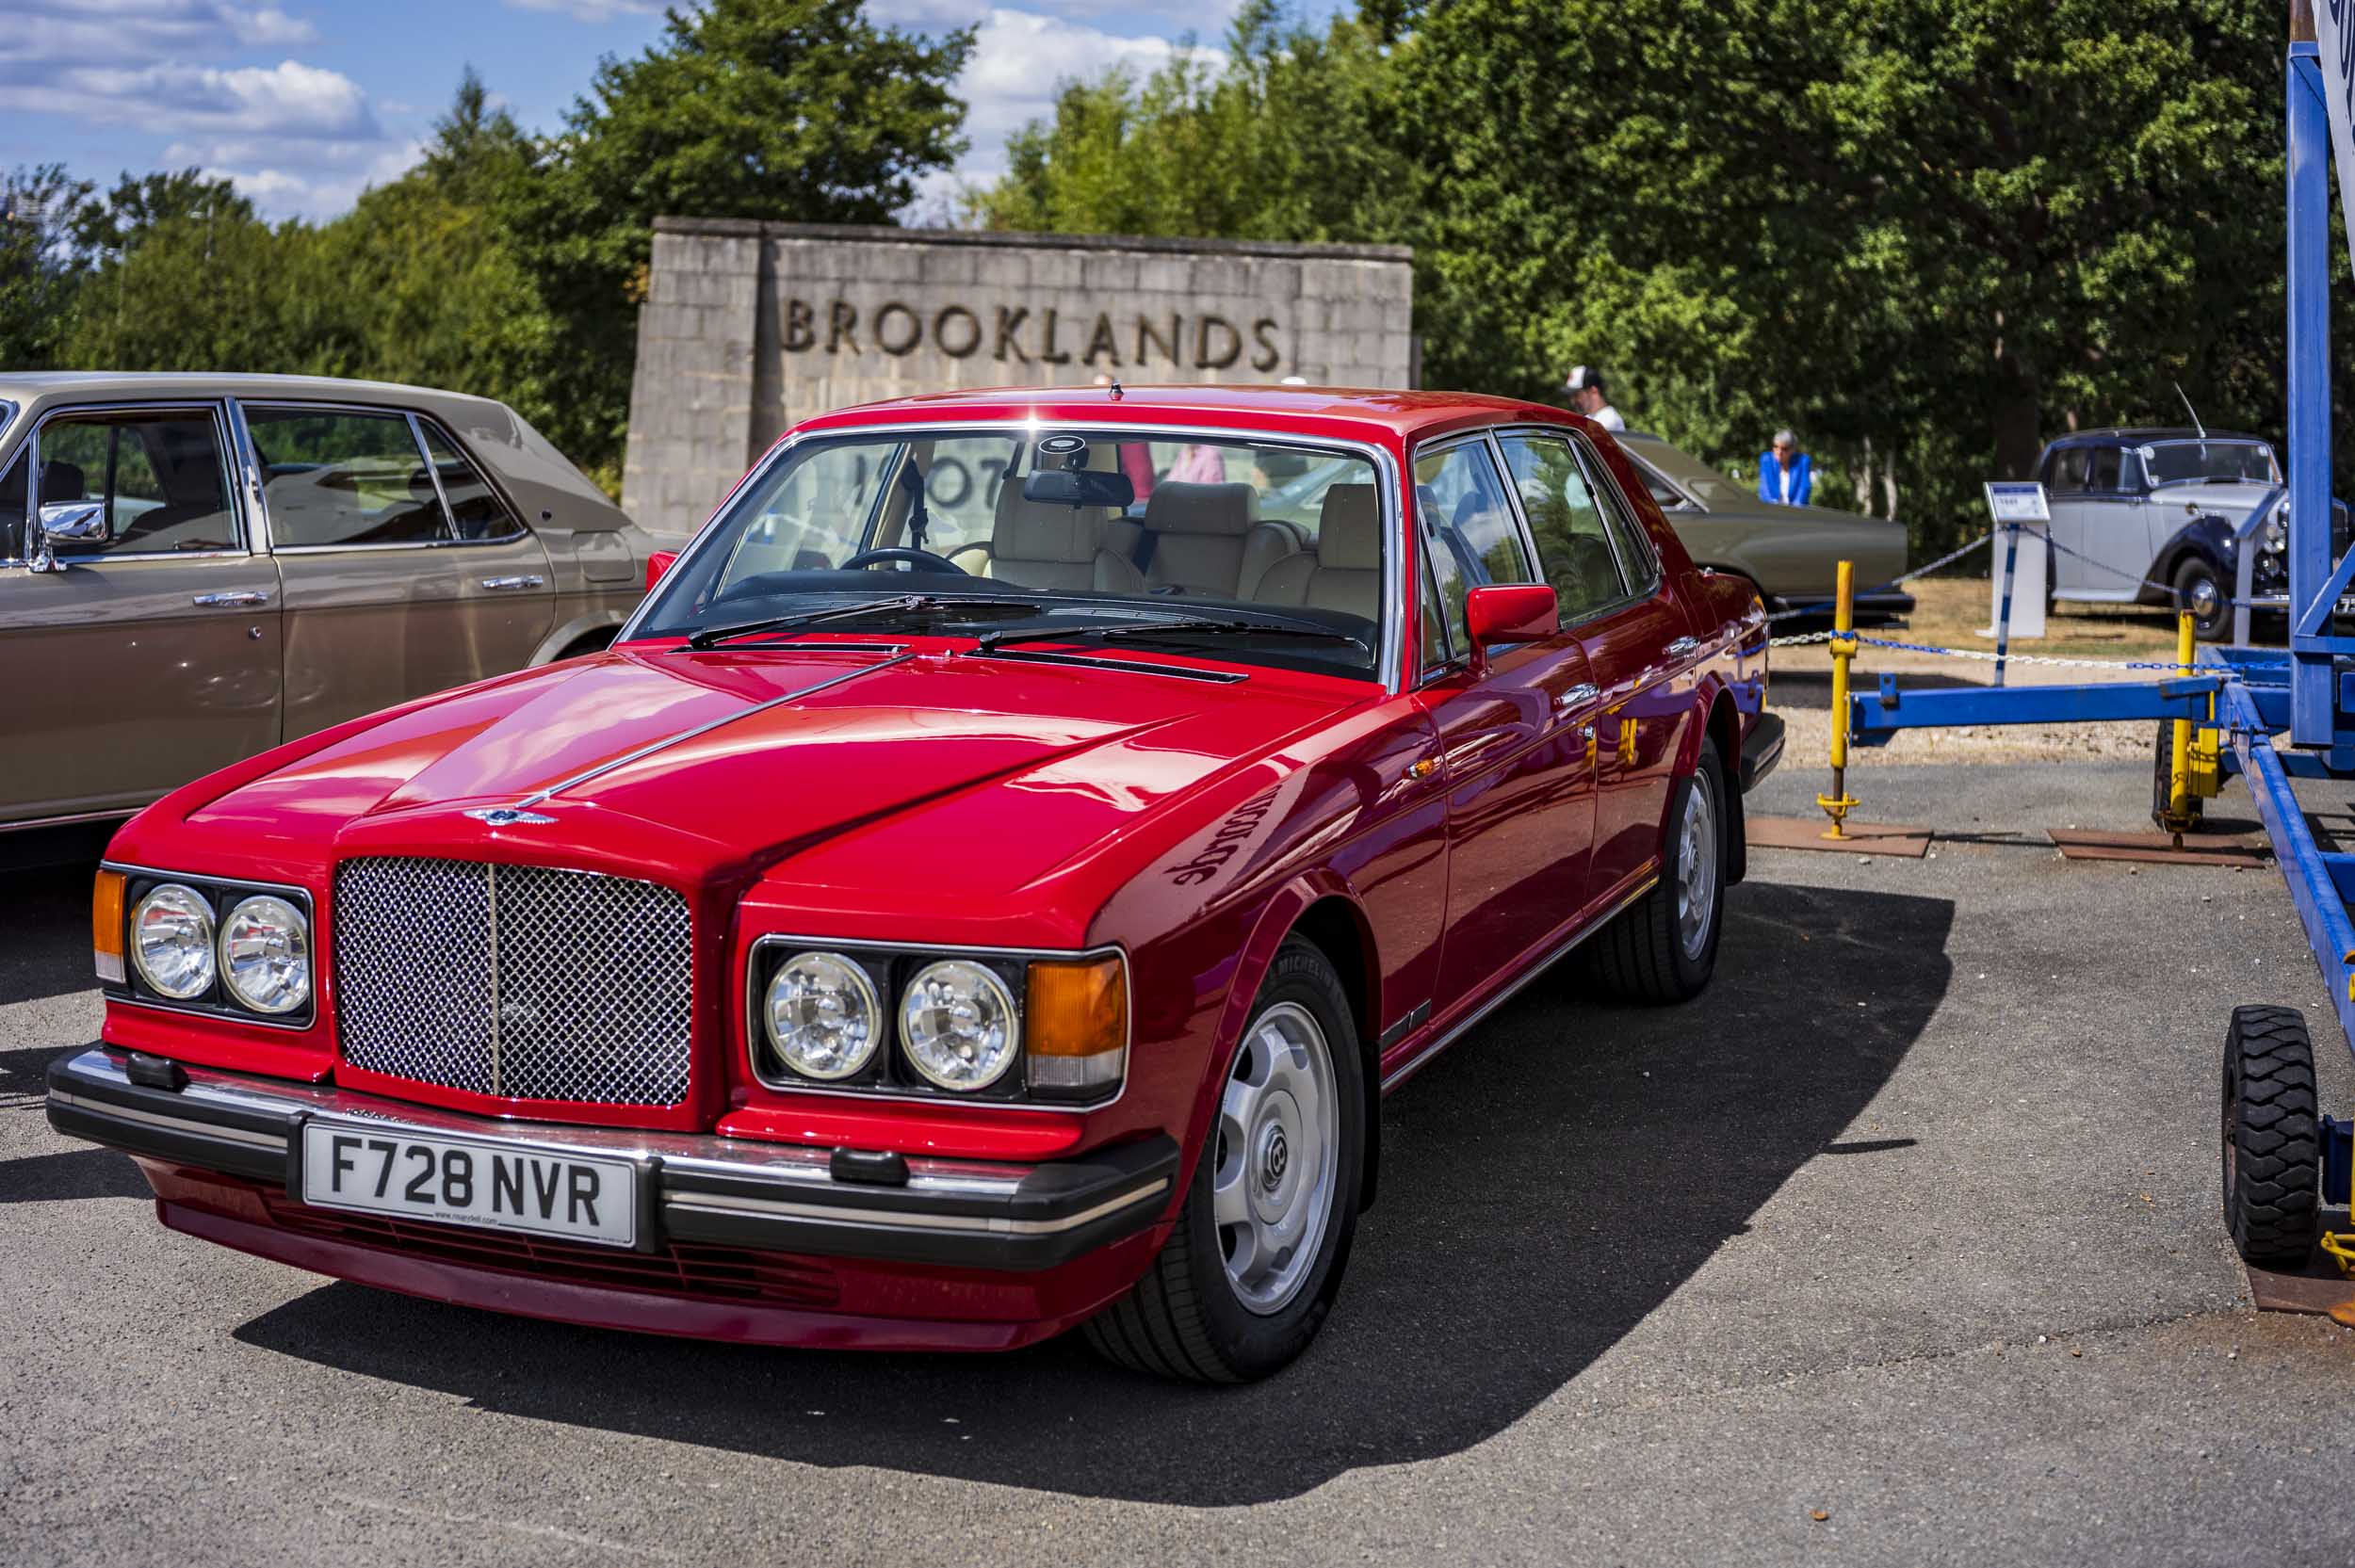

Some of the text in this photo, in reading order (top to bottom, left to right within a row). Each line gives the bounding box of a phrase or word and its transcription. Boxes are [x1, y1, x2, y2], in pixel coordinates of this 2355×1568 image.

[781, 299, 1280, 372] BROOKLANDS
[333, 1135, 600, 1226] F728 NVR
